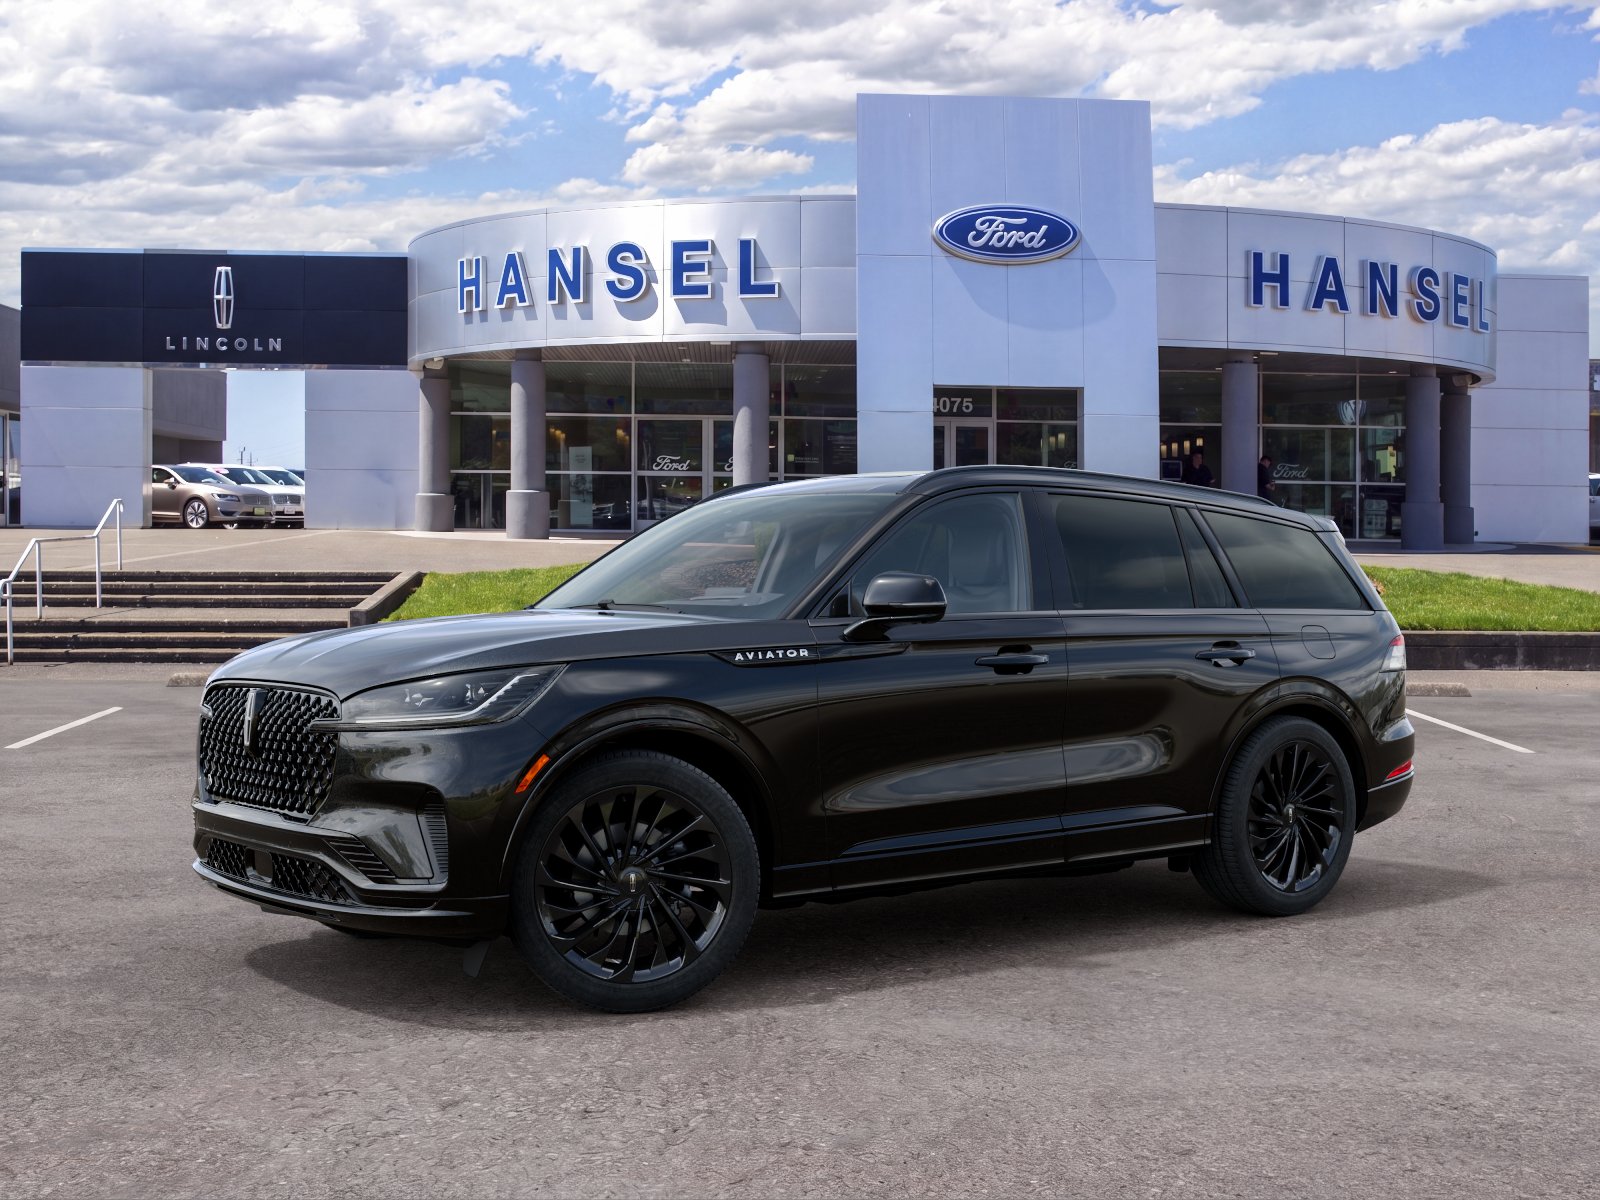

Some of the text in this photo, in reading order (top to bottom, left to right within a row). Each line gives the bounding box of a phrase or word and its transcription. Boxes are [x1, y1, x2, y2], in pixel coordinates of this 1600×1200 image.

[967, 215, 1048, 248] Ford
[457, 238, 780, 314] HANSEL
[1247, 249, 1491, 334] HANSEL
[165, 336, 282, 352] LINCOLN
[652, 454, 690, 471] Ford
[1272, 462, 1310, 479] Ford
[734, 648, 809, 661] AVIATOR
